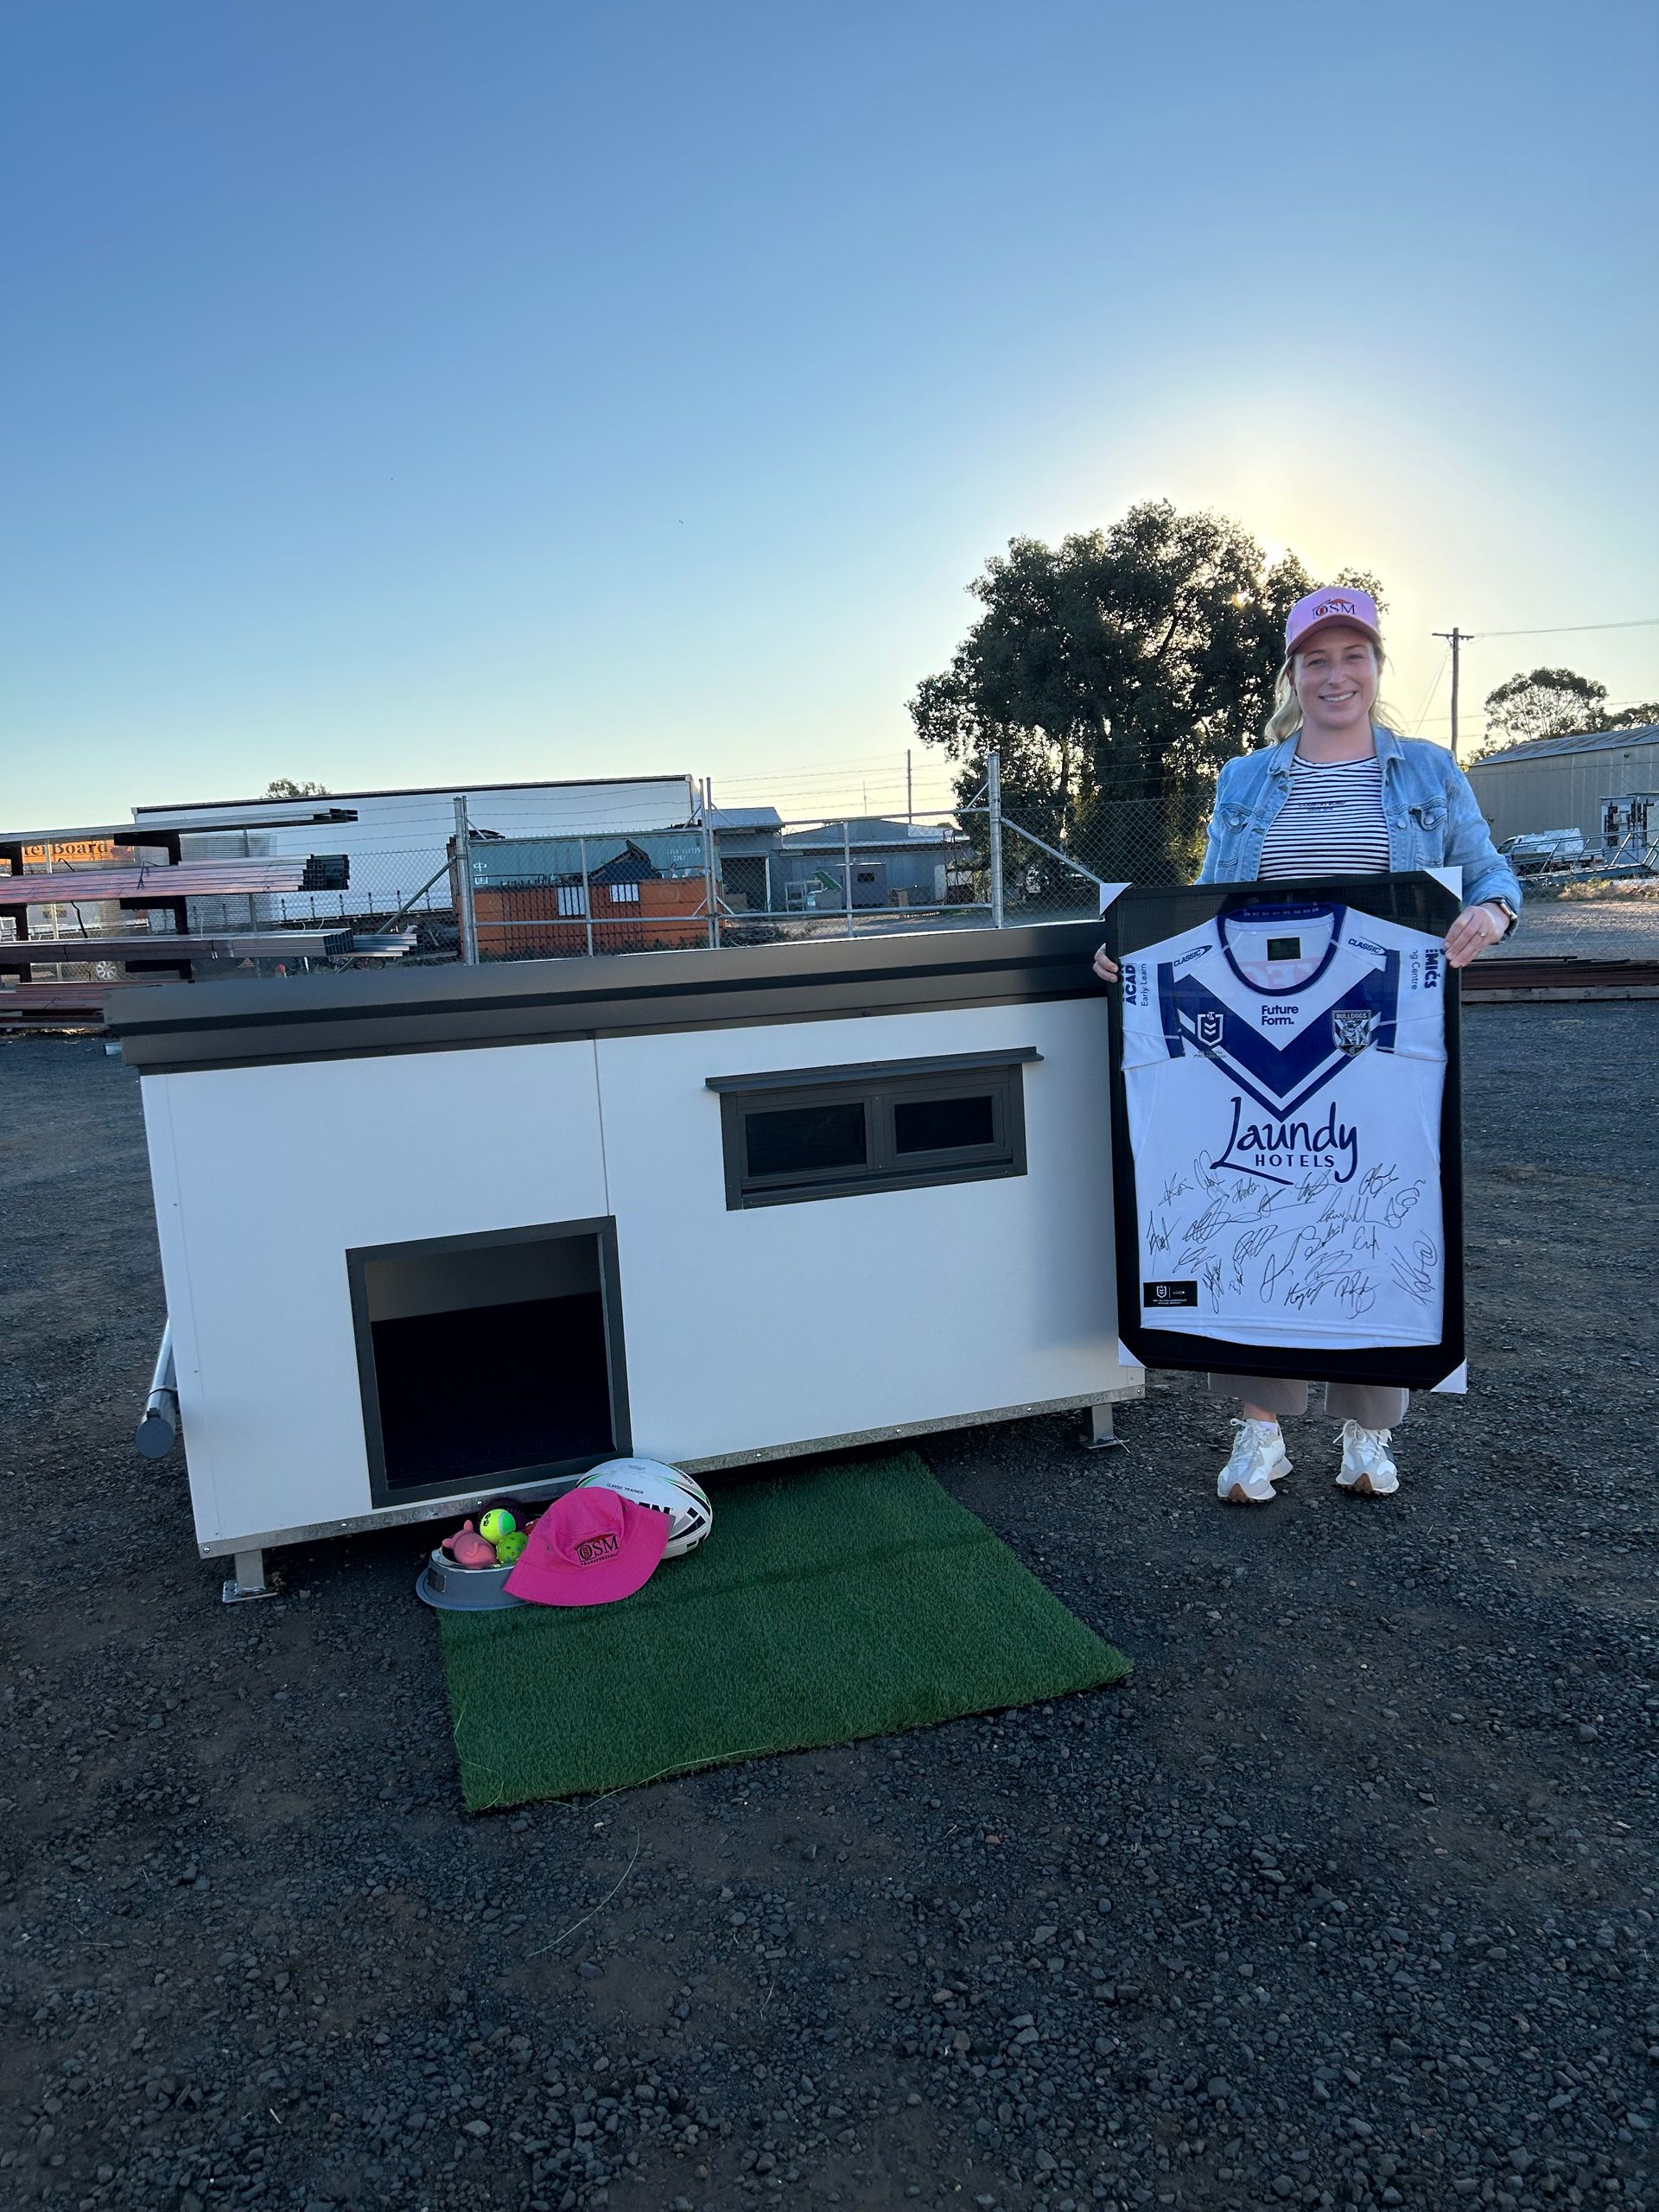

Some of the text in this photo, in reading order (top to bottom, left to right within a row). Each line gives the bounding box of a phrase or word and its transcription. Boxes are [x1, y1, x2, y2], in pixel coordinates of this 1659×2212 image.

[1315, 603, 1357, 616] OSM
[1348, 938, 1381, 955] CLASSIC
[1173, 949, 1201, 967] CLASSIC
[1411, 962, 1421, 991] Centre
[1141, 986, 1150, 1007] Early
[1261, 1005, 1300, 1015] Future
[1261, 1016, 1295, 1026] Form.
[1210, 1096, 1358, 1185] Laundy
[1255, 1154, 1335, 1167] HOTELS
[624, 1486, 645, 1495] TRAINER
[579, 1535, 620, 1560] OSM
